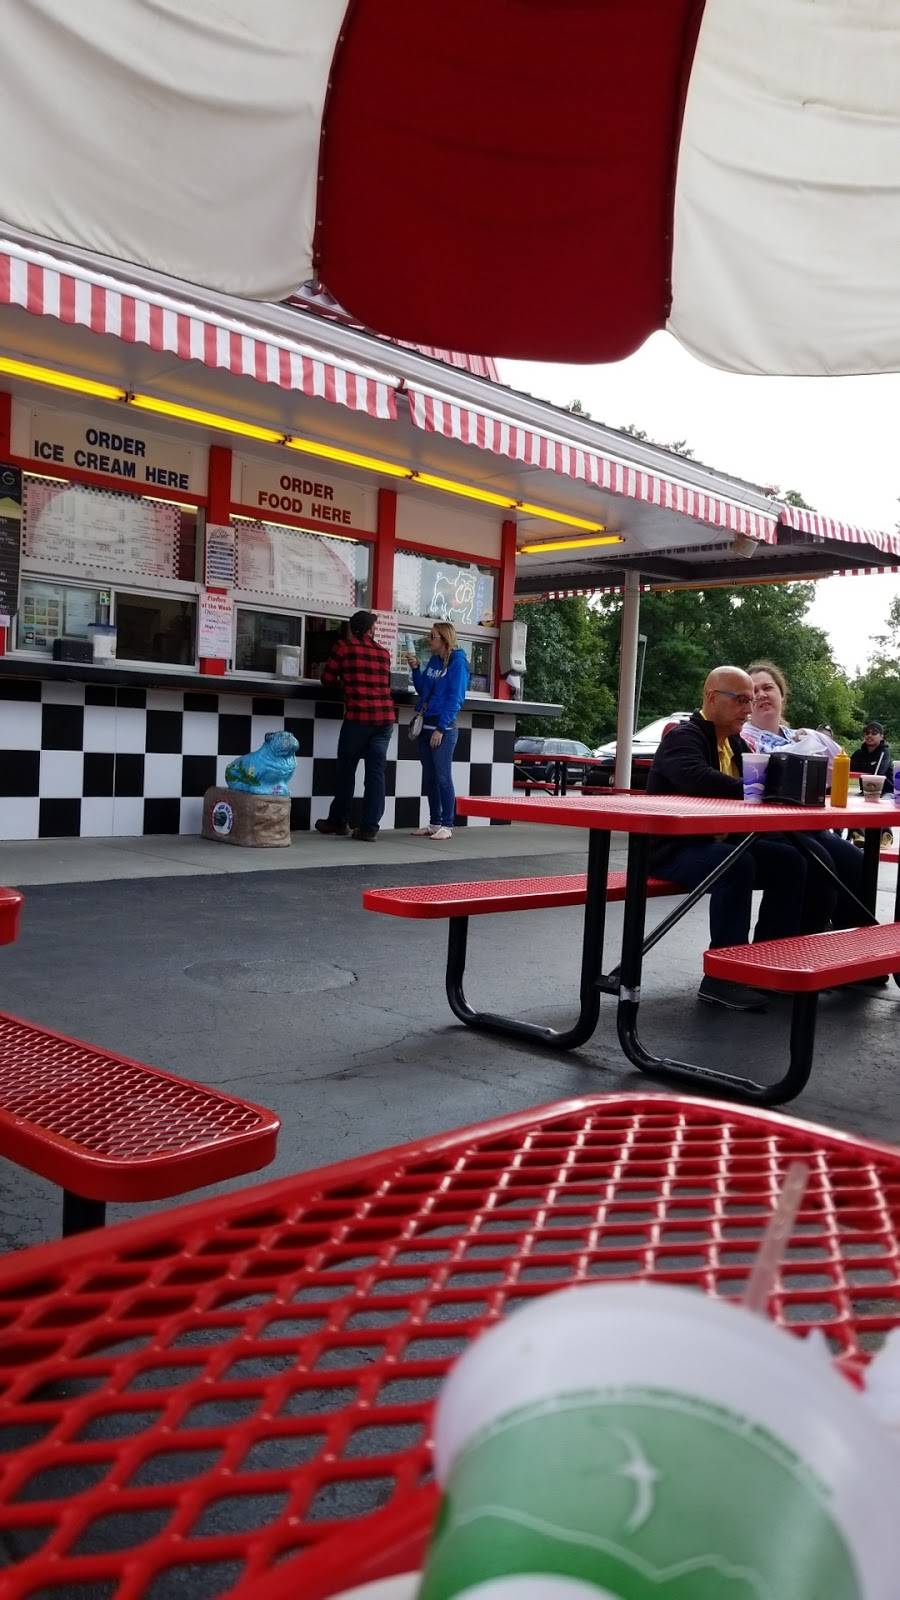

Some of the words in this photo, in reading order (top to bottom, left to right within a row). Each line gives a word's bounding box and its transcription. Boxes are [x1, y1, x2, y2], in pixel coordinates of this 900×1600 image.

[86, 428, 146, 457] ORDER
[34, 440, 65, 462] ICE
[74, 450, 136, 478] CREAM
[145, 466, 190, 490] HERE
[280, 475, 334, 501] ORDER
[258, 491, 303, 514] FOOD
[311, 503, 352, 525] HERE
